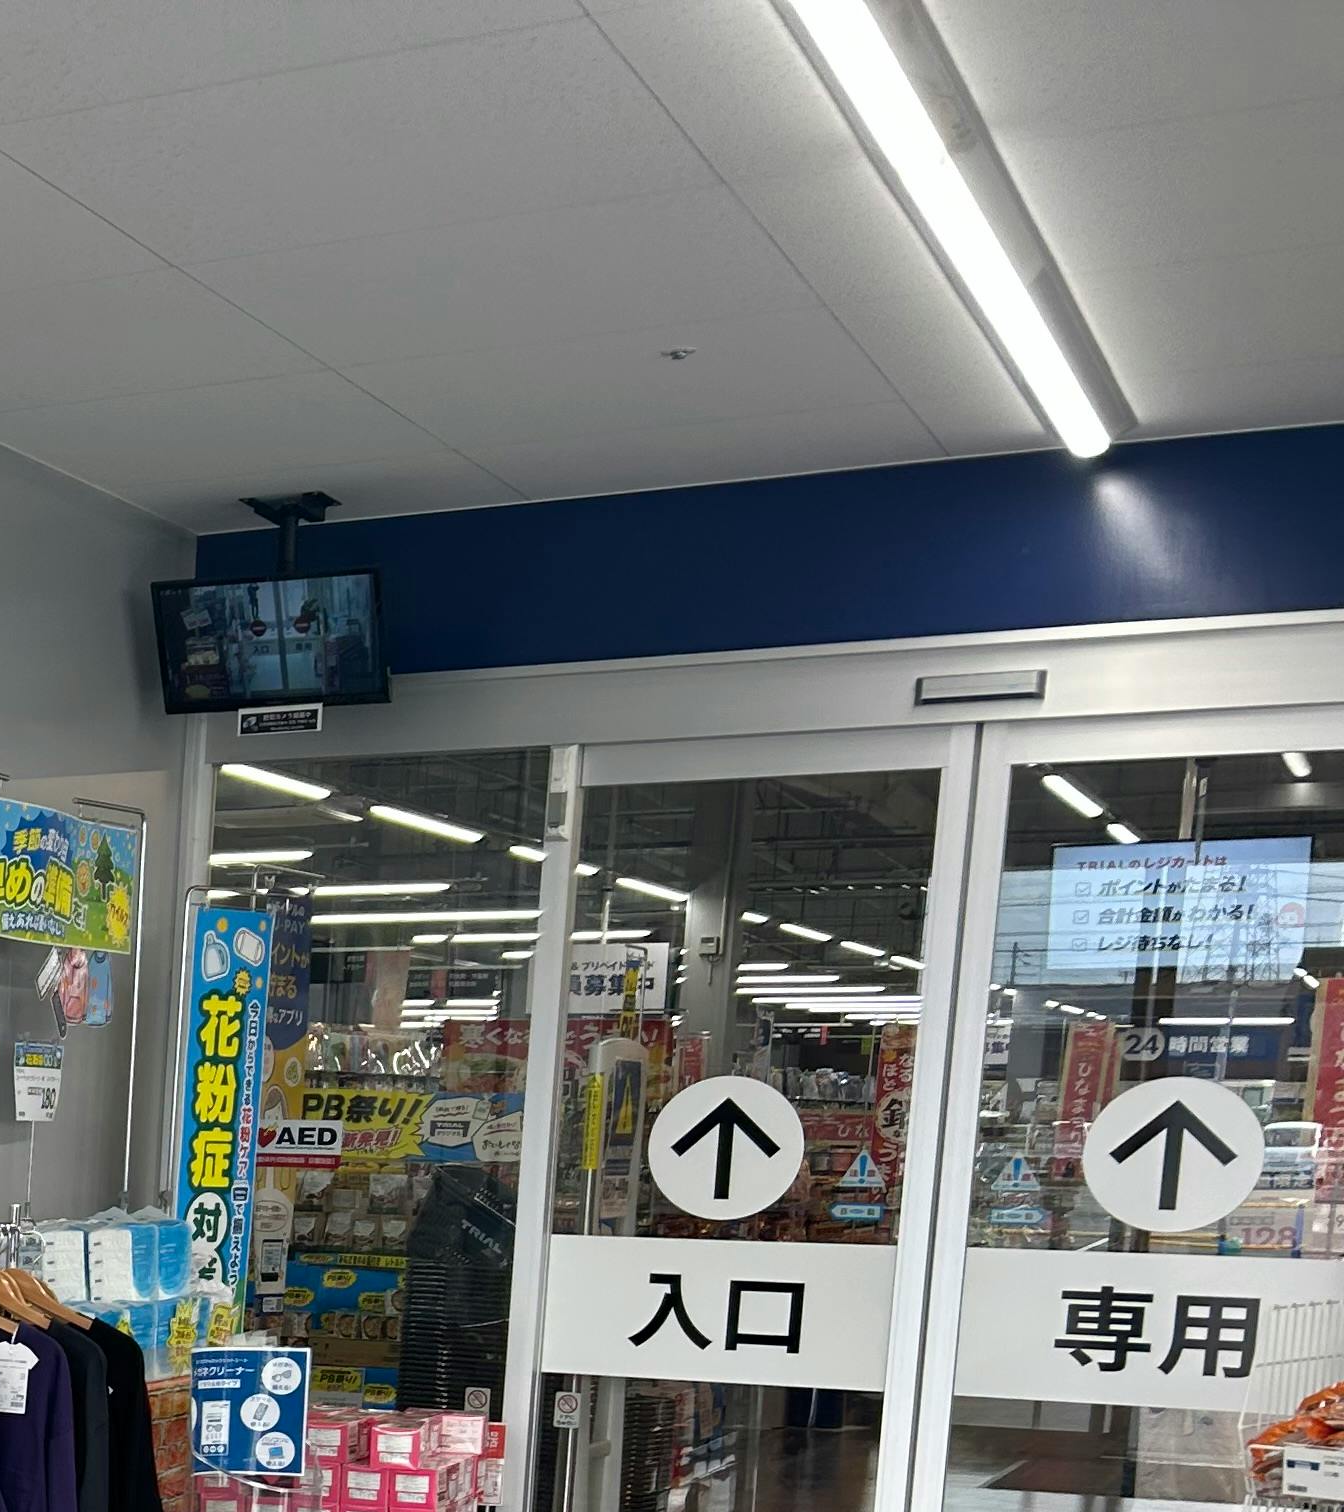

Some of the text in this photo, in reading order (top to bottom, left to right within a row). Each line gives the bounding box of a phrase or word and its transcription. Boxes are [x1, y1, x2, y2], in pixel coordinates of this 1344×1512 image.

[1124, 1033, 1250, 1056] 24 時間営業
[302, 1093, 423, 1124] PB祭り!
[275, 1127, 338, 1147] AED
[461, 1218, 504, 1255] TRIAL
[628, 1273, 805, 1354] 入口
[1054, 1286, 1261, 1379] 専用
